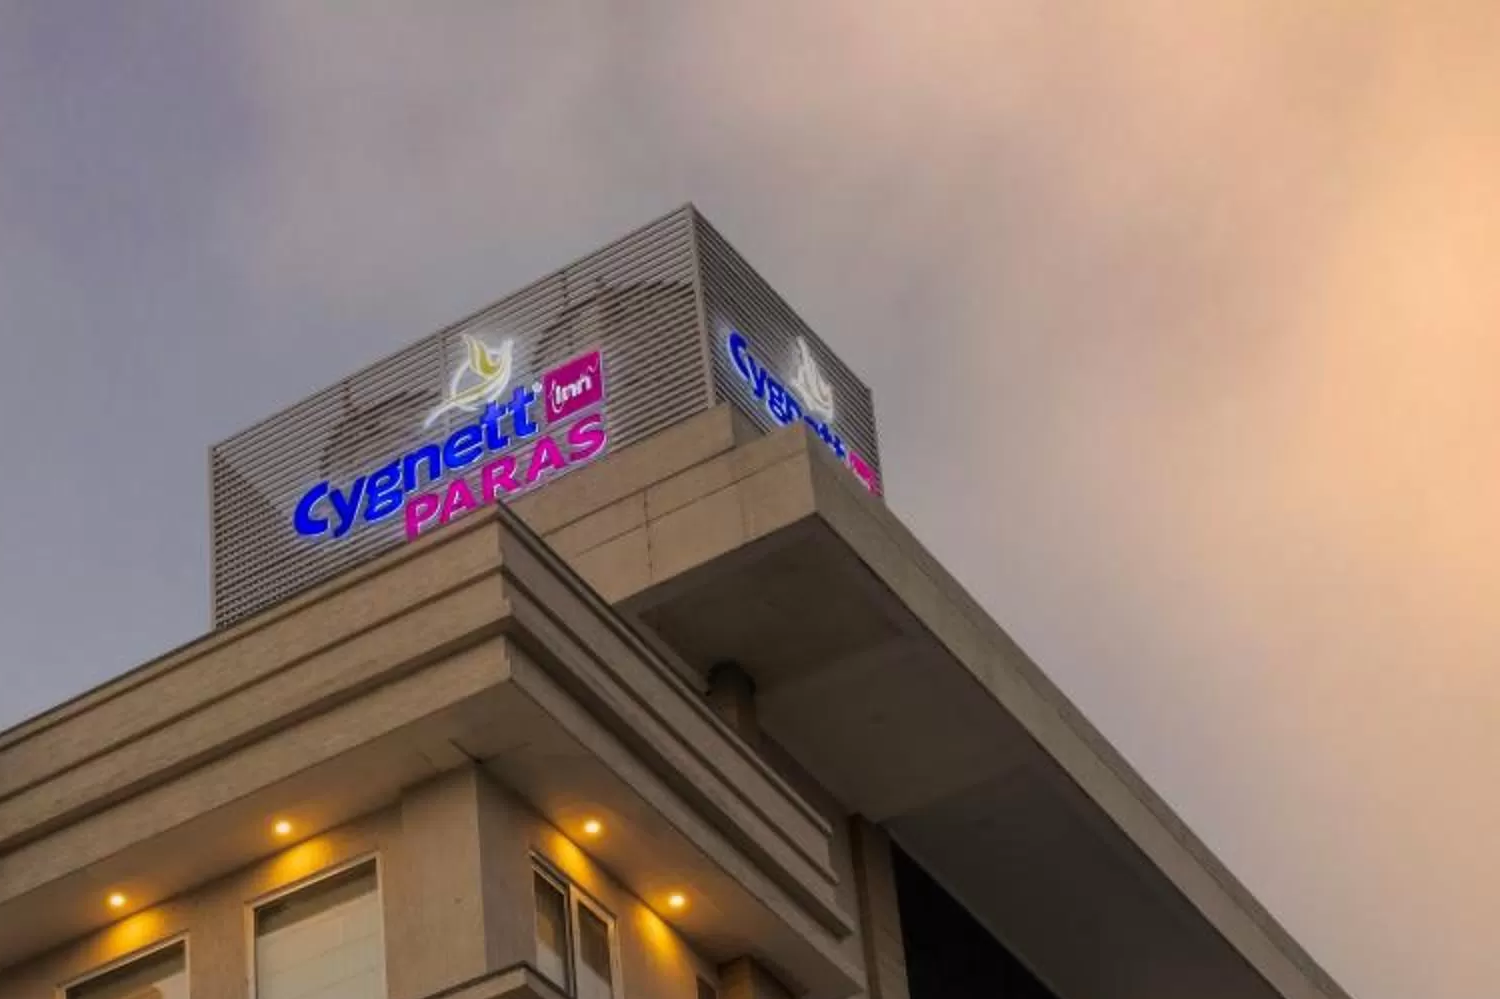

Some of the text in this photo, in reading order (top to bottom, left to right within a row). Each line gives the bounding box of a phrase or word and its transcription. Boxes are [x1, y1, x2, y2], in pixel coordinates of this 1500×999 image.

[293, 372, 594, 538] Cygnett Inn
[404, 413, 607, 544] PARAS
